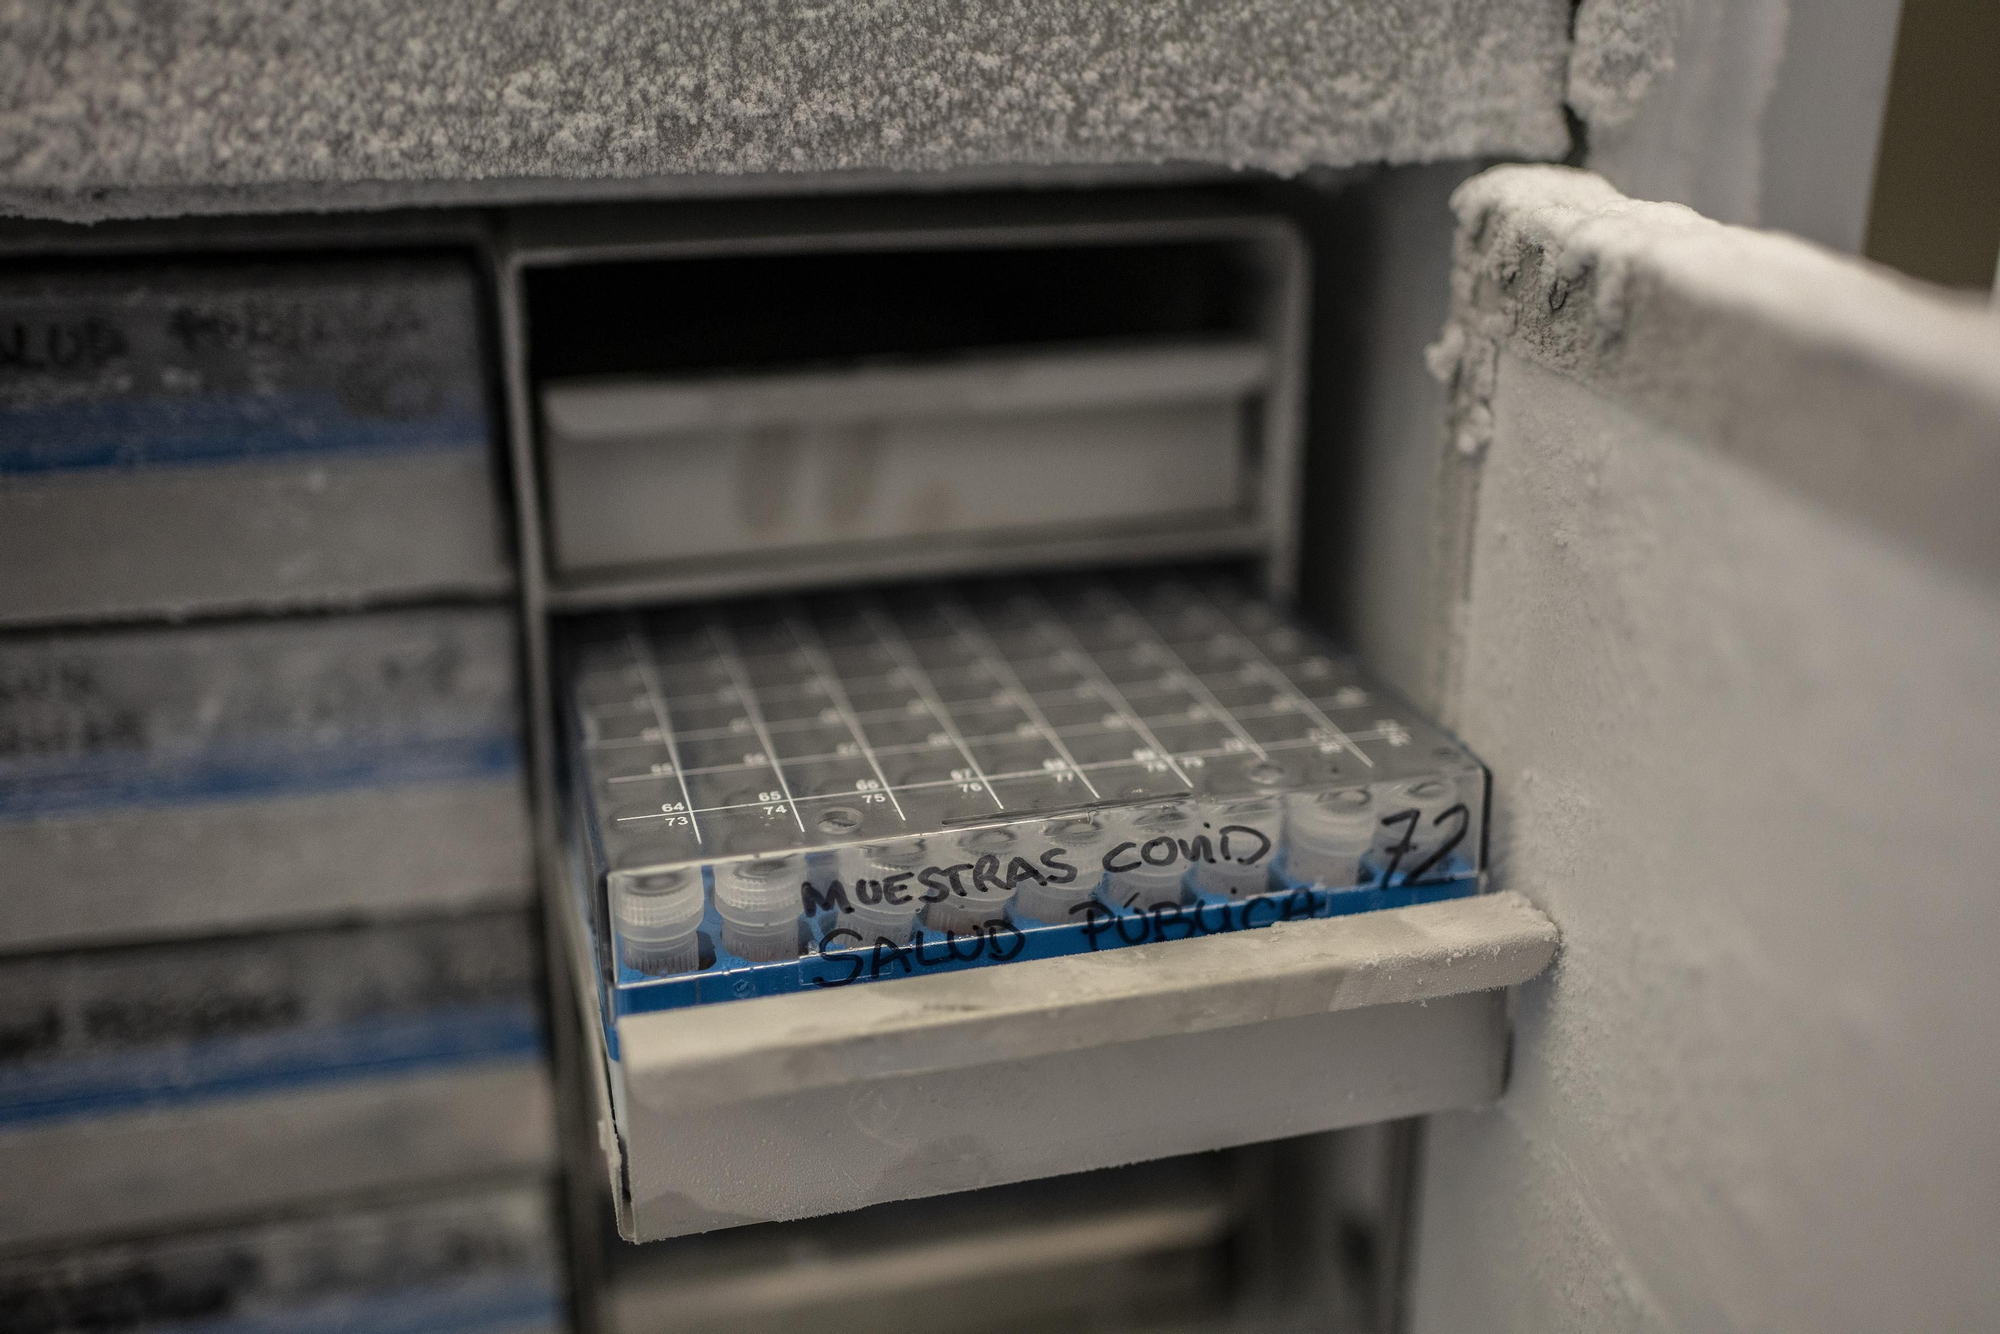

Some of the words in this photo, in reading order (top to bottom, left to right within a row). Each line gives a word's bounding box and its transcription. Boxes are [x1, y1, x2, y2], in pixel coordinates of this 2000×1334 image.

[661, 801, 685, 813] 64
[758, 790, 782, 802] 65
[855, 778, 880, 791] 66
[664, 815, 689, 827] 73
[762, 803, 788, 815] 74
[861, 793, 886, 804] 75
[957, 782, 982, 793] 76
[1382, 804, 1470, 890] 72
[801, 848, 1078, 918] MUESTRAS
[812, 919, 1026, 988] SALUD
